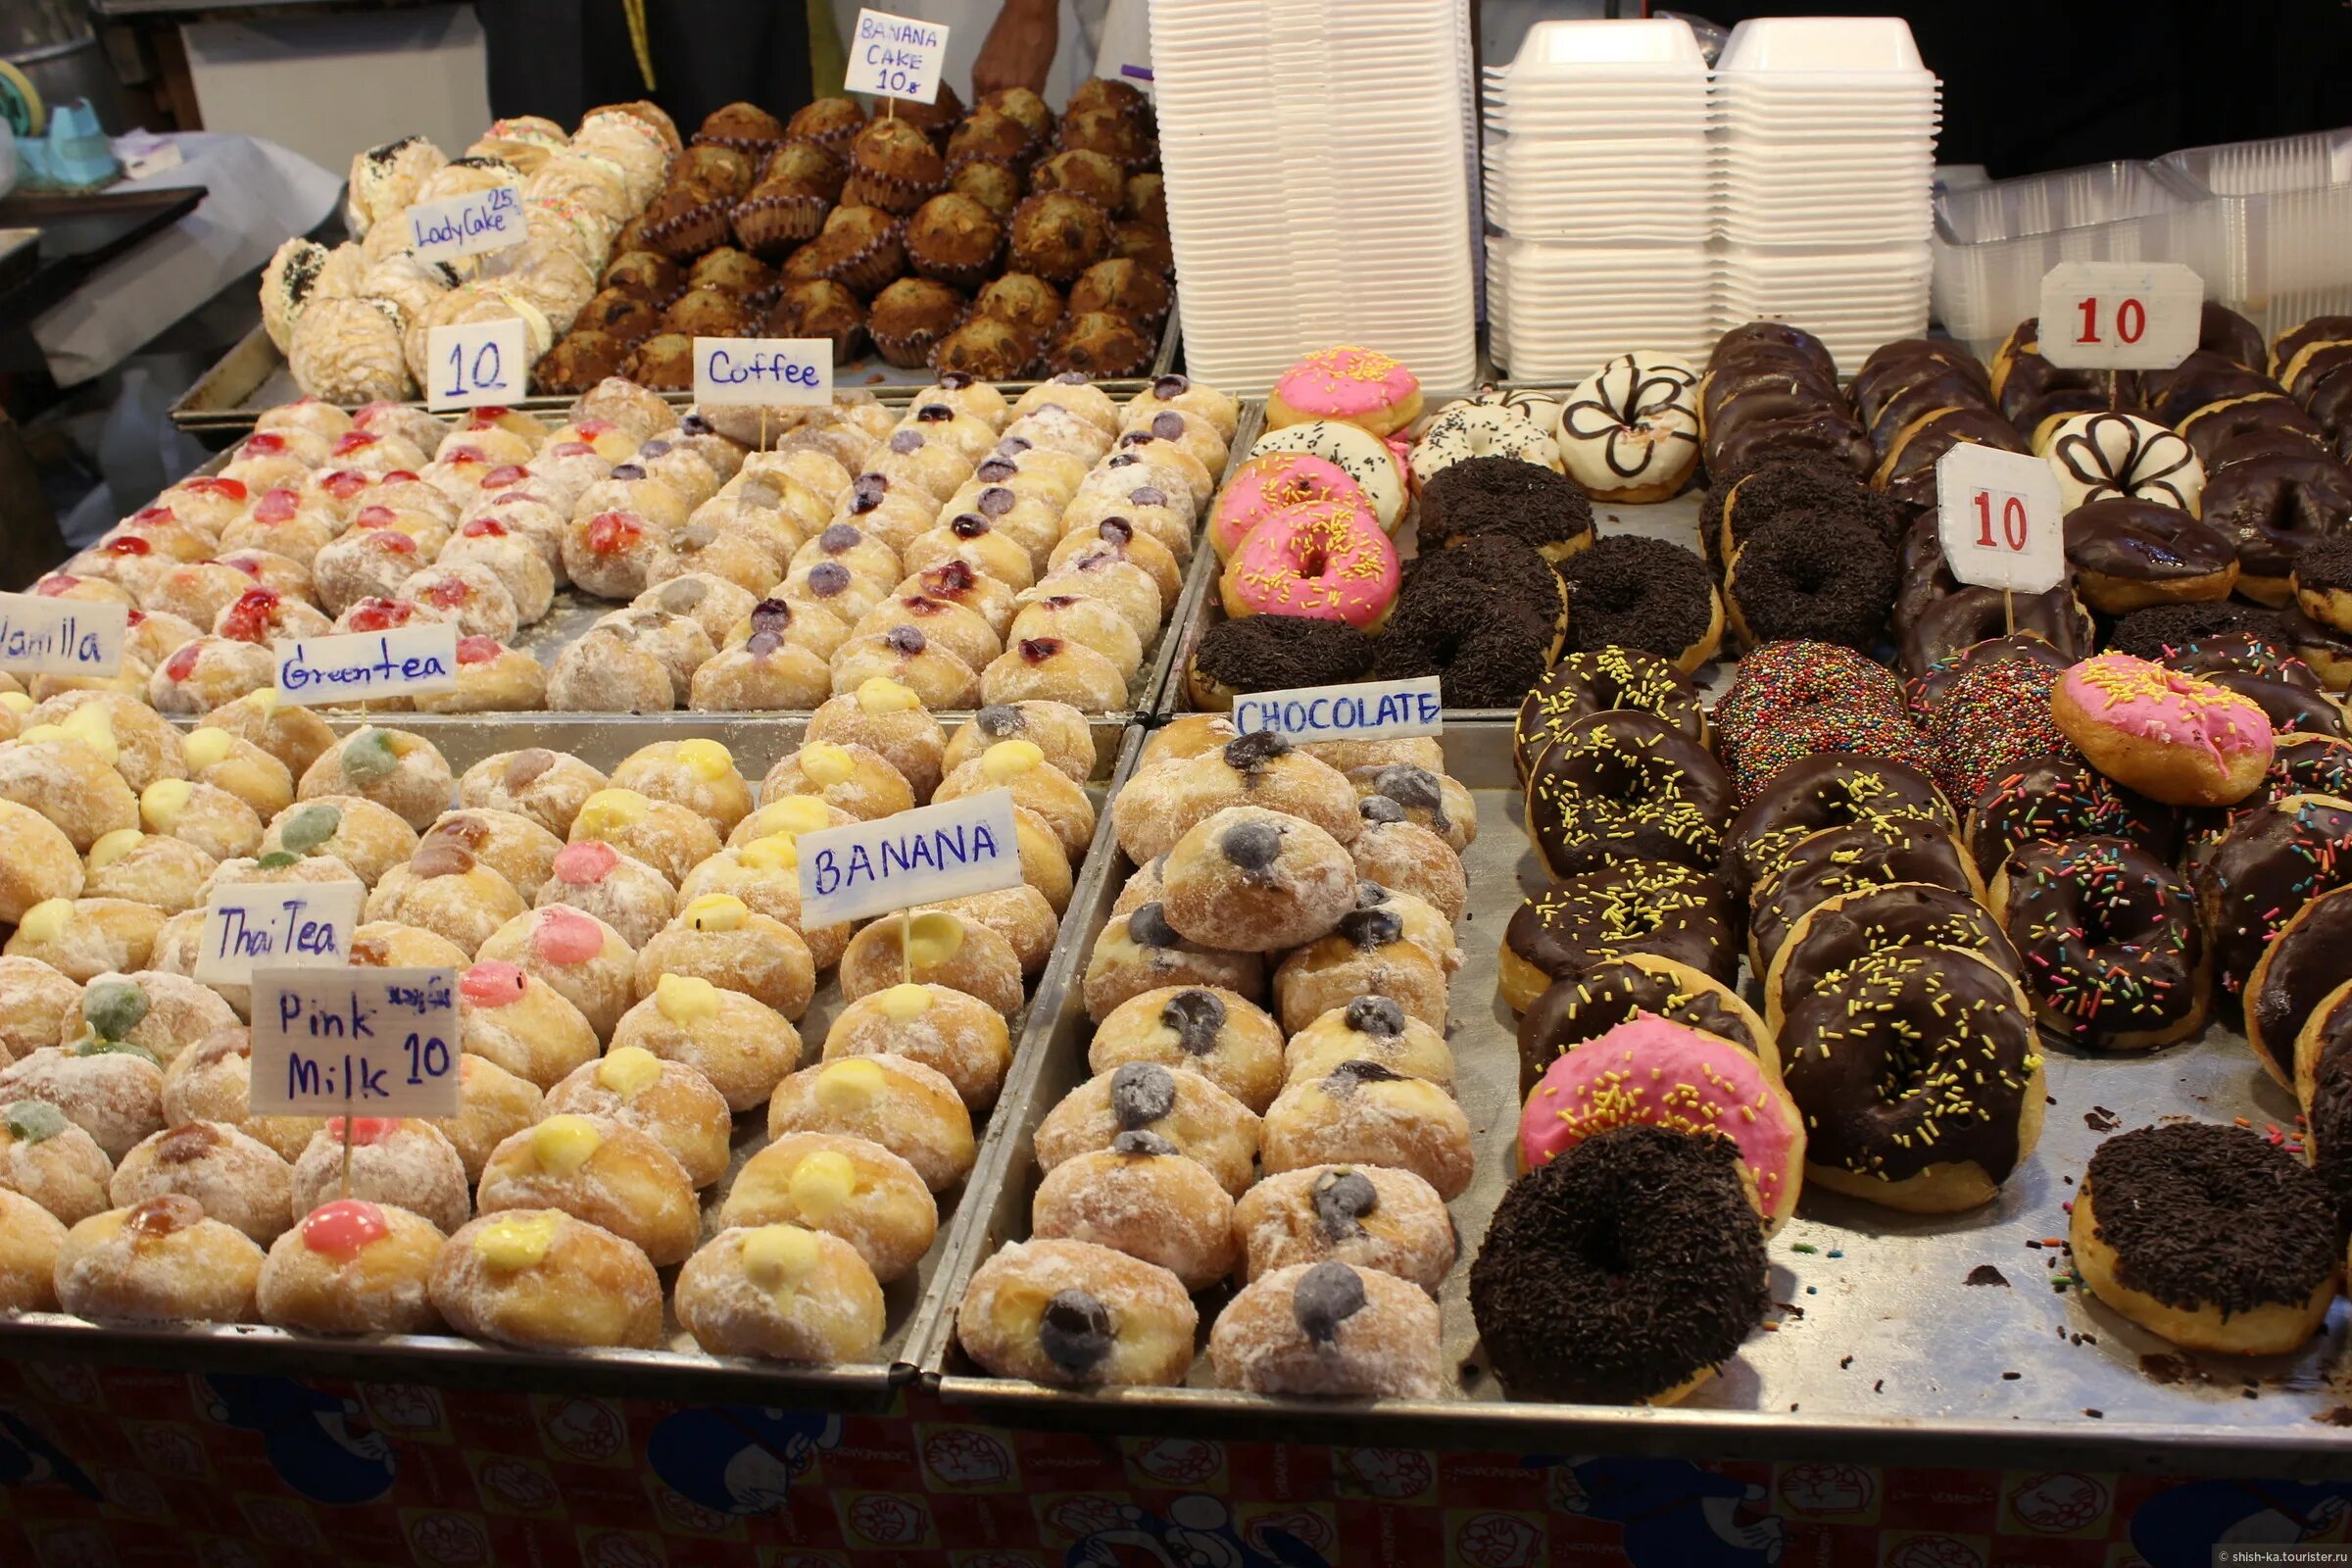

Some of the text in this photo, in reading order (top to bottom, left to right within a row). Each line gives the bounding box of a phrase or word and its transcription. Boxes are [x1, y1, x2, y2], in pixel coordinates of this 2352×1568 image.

[861, 18, 938, 48] BANANA
[866, 44, 922, 70] CAKE
[2076, 297, 2146, 344] 10
[709, 350, 820, 387] Coffee
[1974, 491, 2029, 552] 10
[1237, 692, 1441, 735] CHOCOLATE
[815, 819, 998, 896] BANANA
[279, 989, 378, 1040] Pink
[288, 1053, 389, 1100] Milk
[404, 1033, 450, 1085] 10
